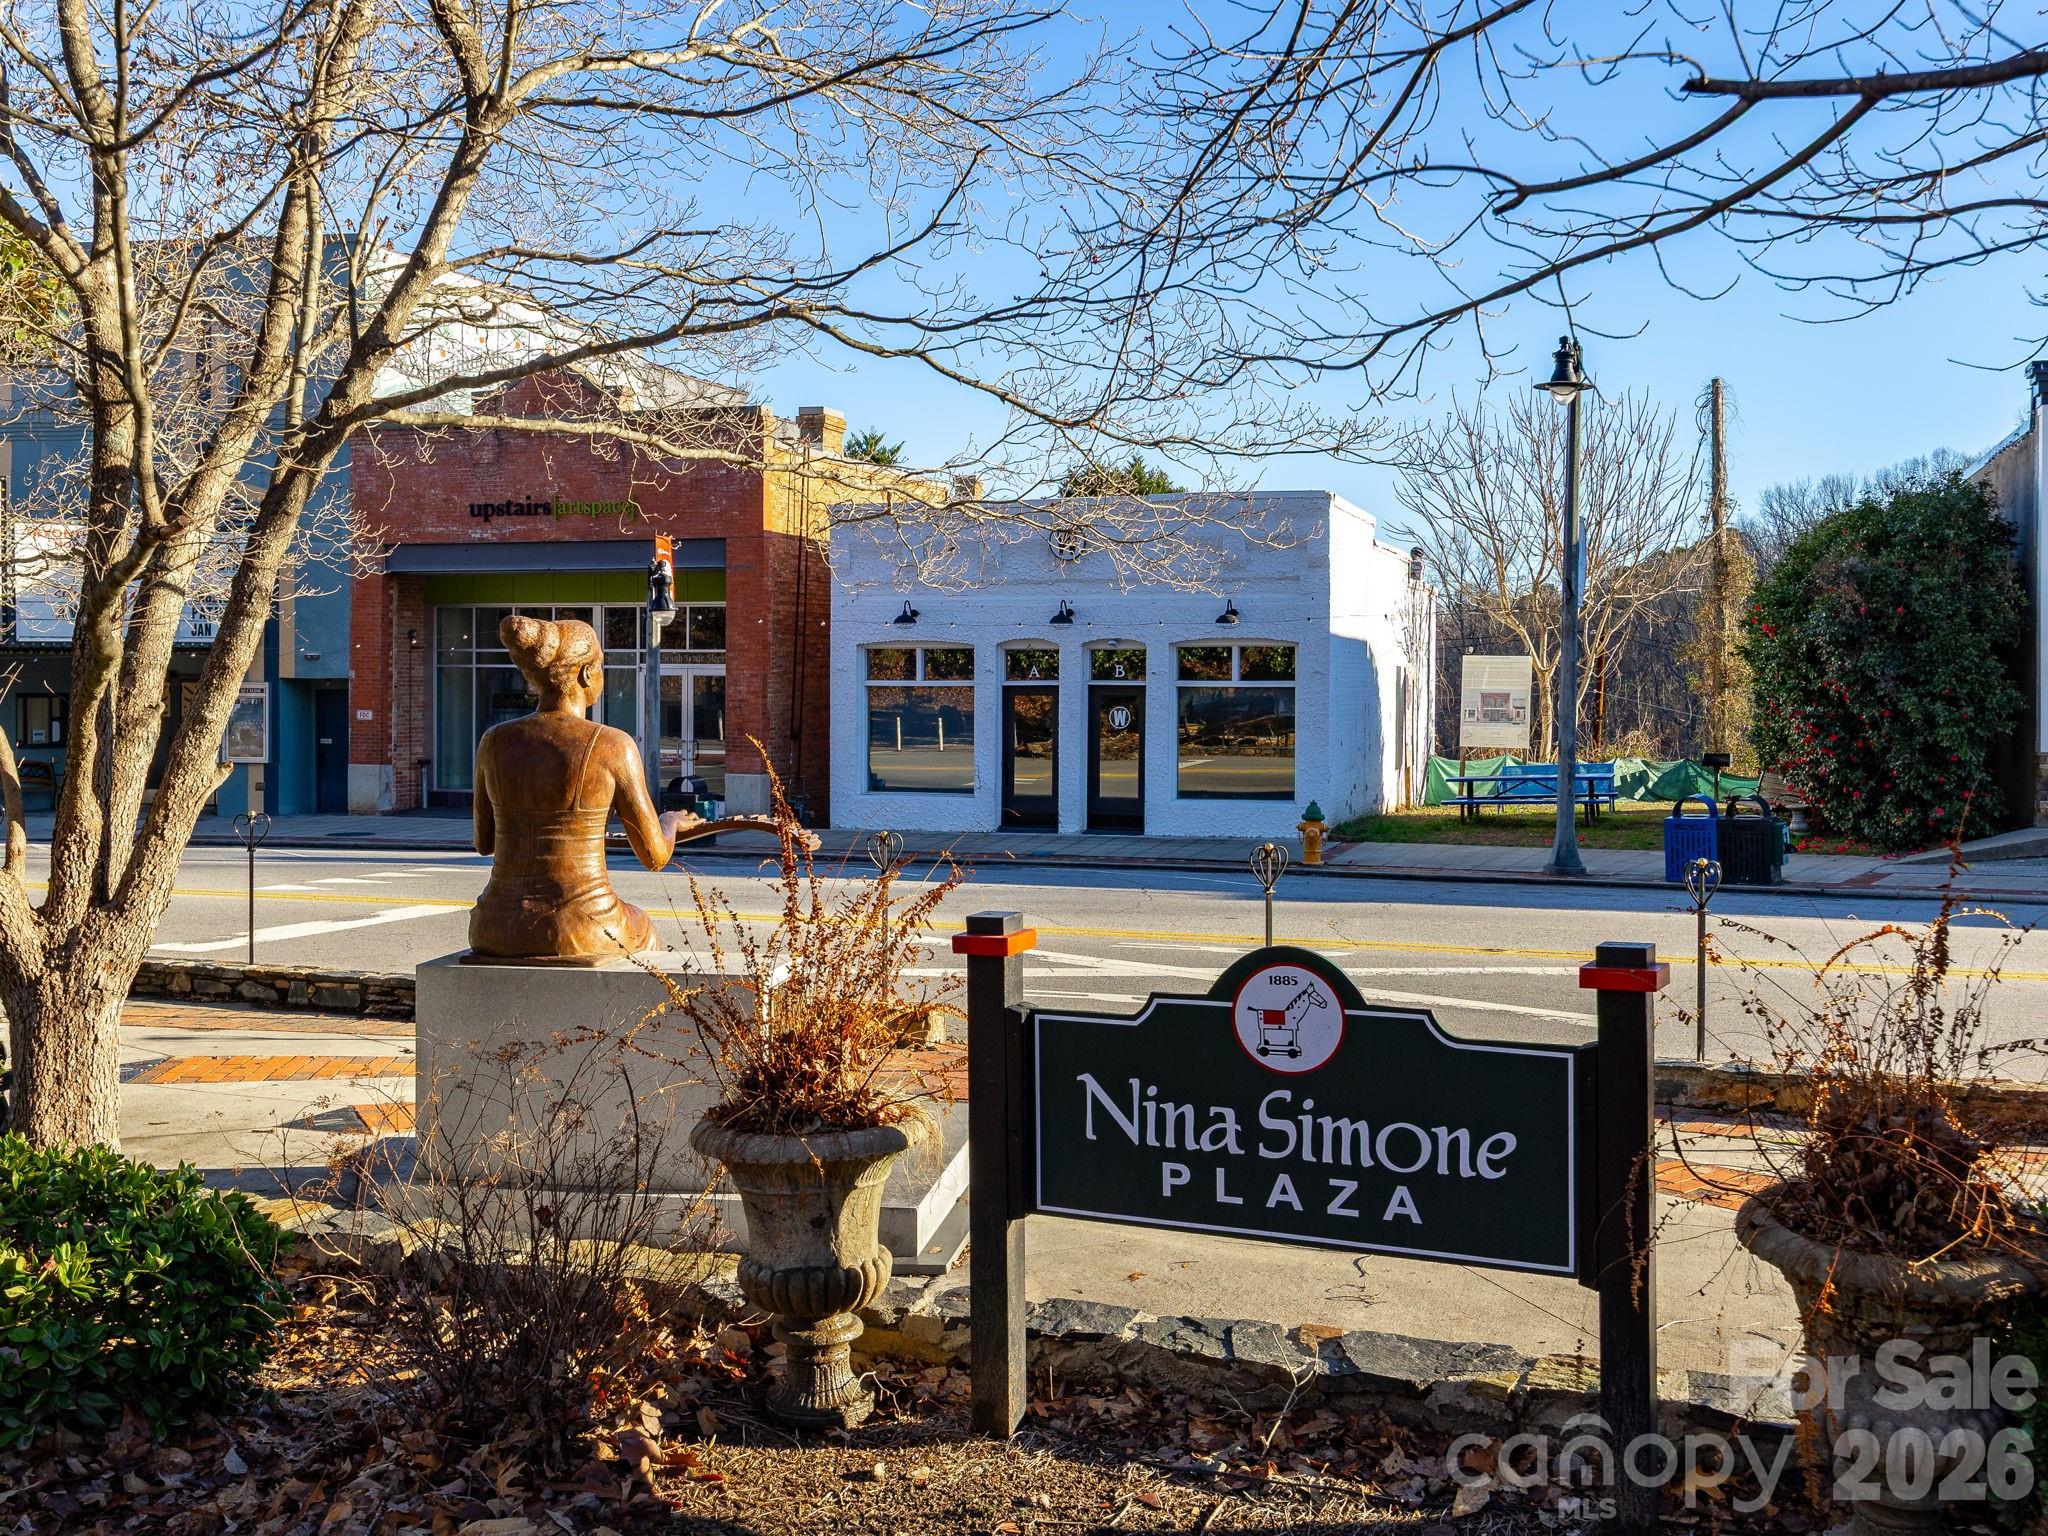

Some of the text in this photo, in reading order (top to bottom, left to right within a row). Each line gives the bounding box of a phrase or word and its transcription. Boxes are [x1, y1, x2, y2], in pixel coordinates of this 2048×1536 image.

[469, 495, 552, 522] upstairs
[191, 623, 212, 637] JAN
[1029, 665, 1040, 677] A
[1114, 665, 1126, 677] B
[1113, 710, 1127, 726] W
[1267, 974, 1298, 987] 1885
[1076, 1072, 1517, 1180] Nina Simone
[1161, 1161, 1424, 1225] PLAZA
